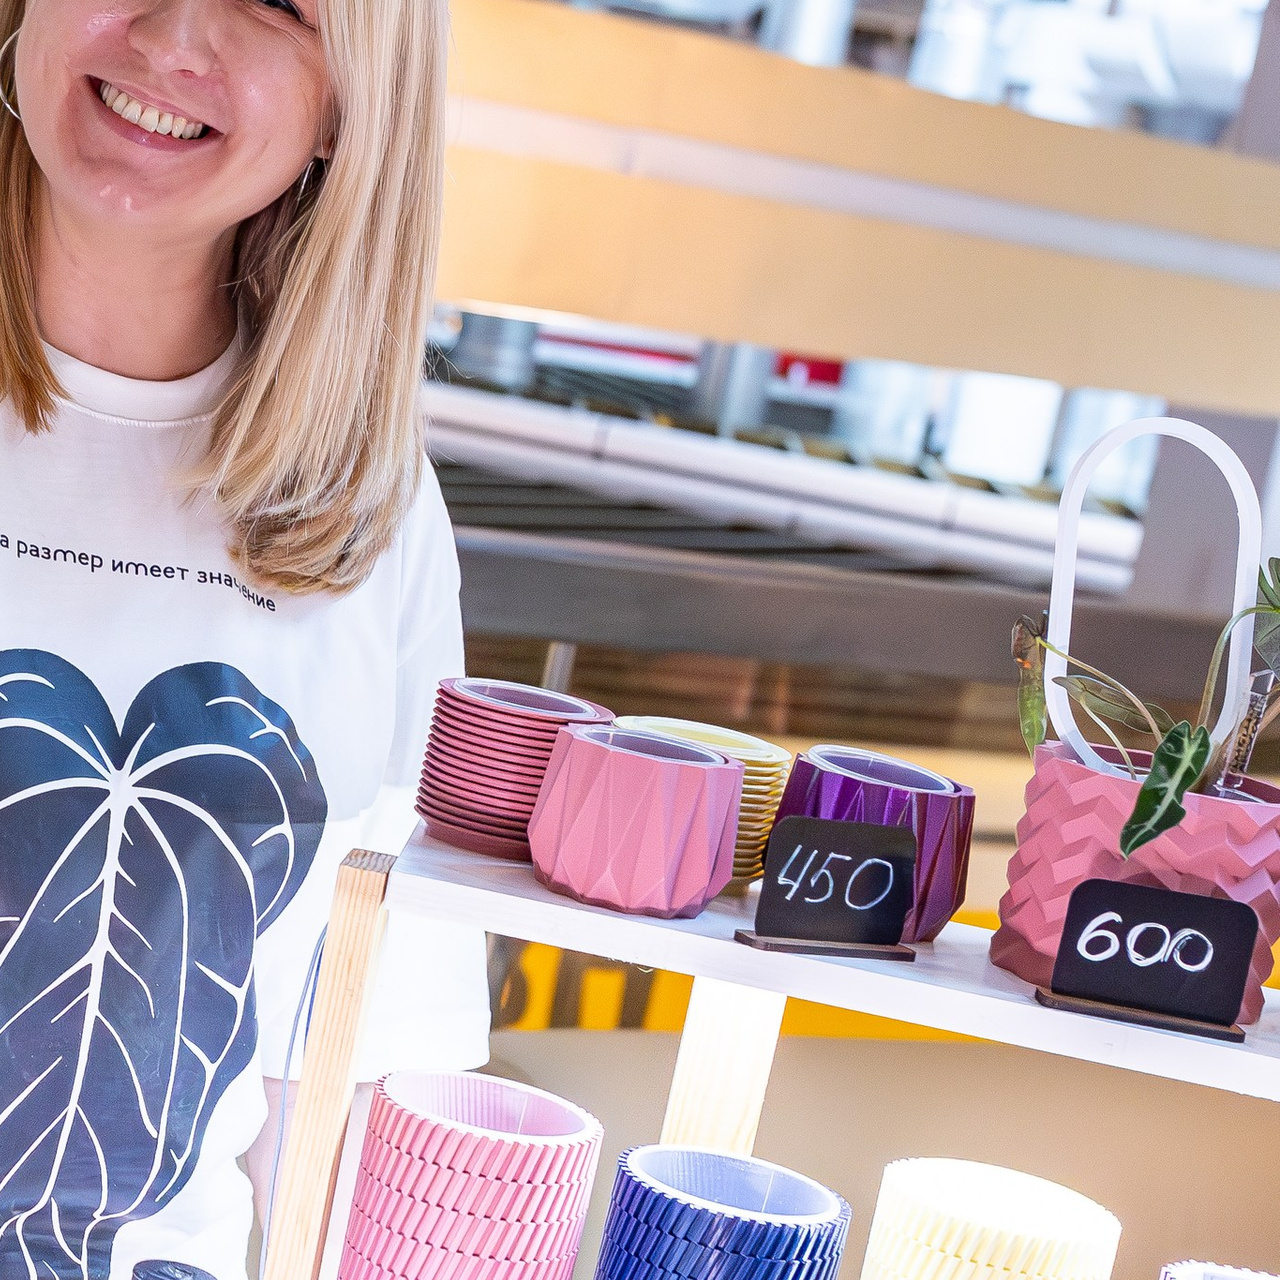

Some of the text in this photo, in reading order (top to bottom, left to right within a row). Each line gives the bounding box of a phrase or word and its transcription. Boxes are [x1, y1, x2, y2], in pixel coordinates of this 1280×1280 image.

[16, 539, 104, 572] размер
[111, 557, 190, 581] имеет
[197, 570, 276, 612] значение
[776, 843, 894, 910] 450
[1076, 911, 1214, 973] 600
